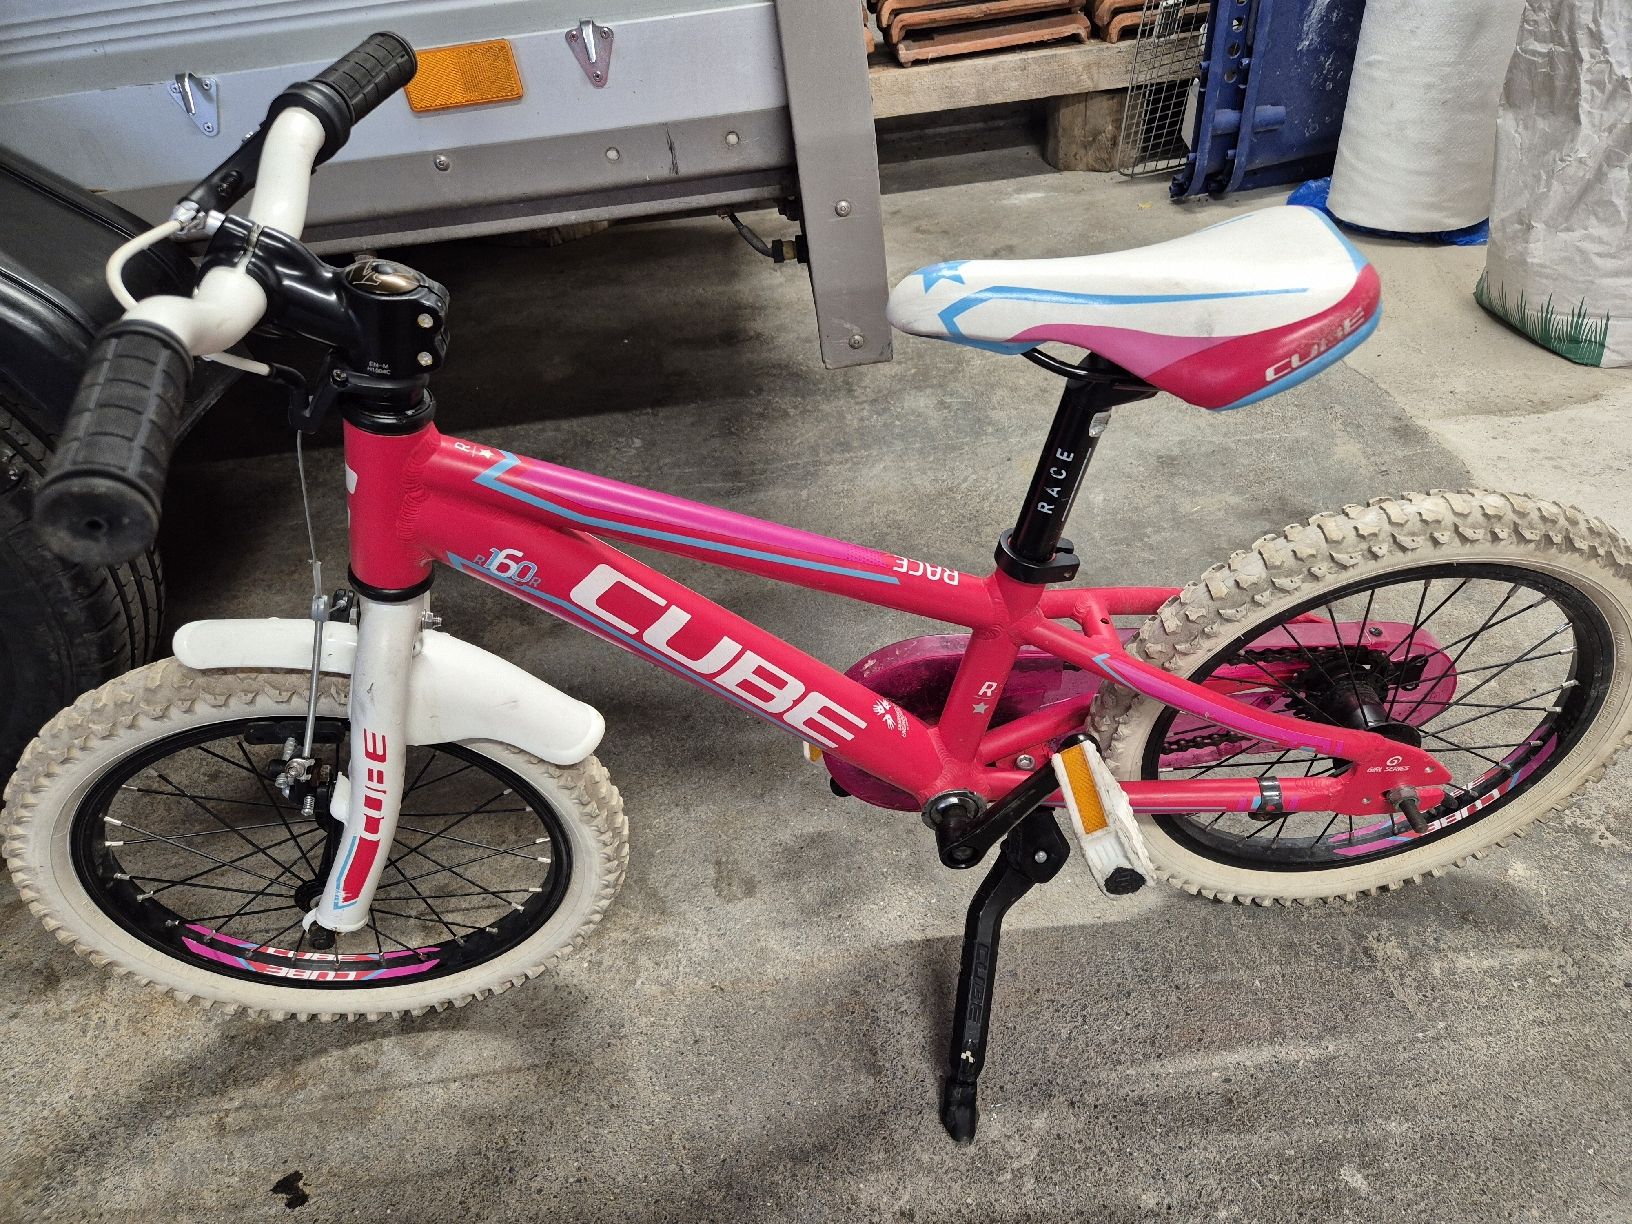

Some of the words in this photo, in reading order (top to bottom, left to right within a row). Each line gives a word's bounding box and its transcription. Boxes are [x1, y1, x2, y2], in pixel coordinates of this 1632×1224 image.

[1037, 447, 1075, 514] RACE
[893, 555, 959, 586] RACE
[570, 564, 868, 749] CUBE
[978, 681, 998, 697] R
[360, 728, 388, 841] CUBE
[263, 965, 357, 981] CUBE
